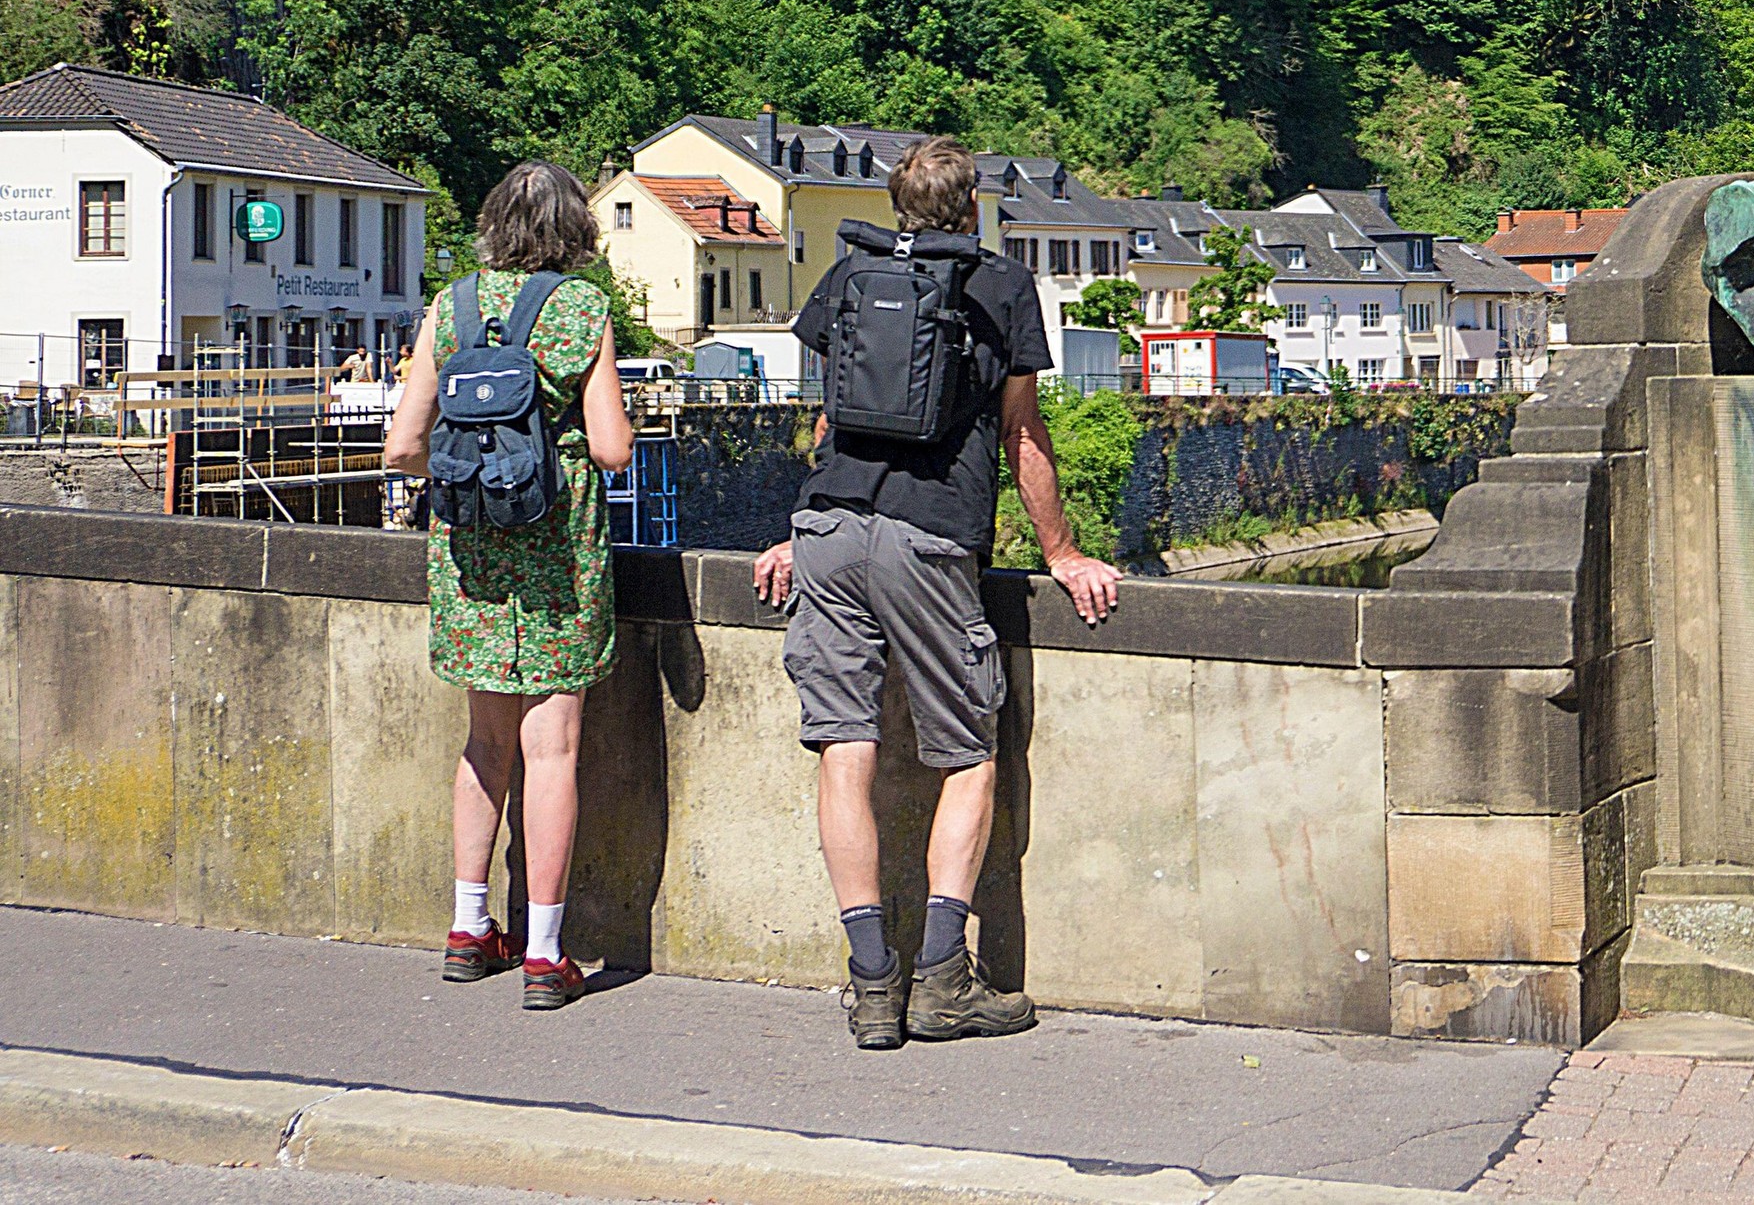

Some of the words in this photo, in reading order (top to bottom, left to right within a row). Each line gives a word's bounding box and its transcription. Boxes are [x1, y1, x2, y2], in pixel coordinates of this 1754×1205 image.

[0, 184, 53, 200] Corner
[277, 274, 302, 295] Petit
[304, 275, 360, 297] Restaurant
